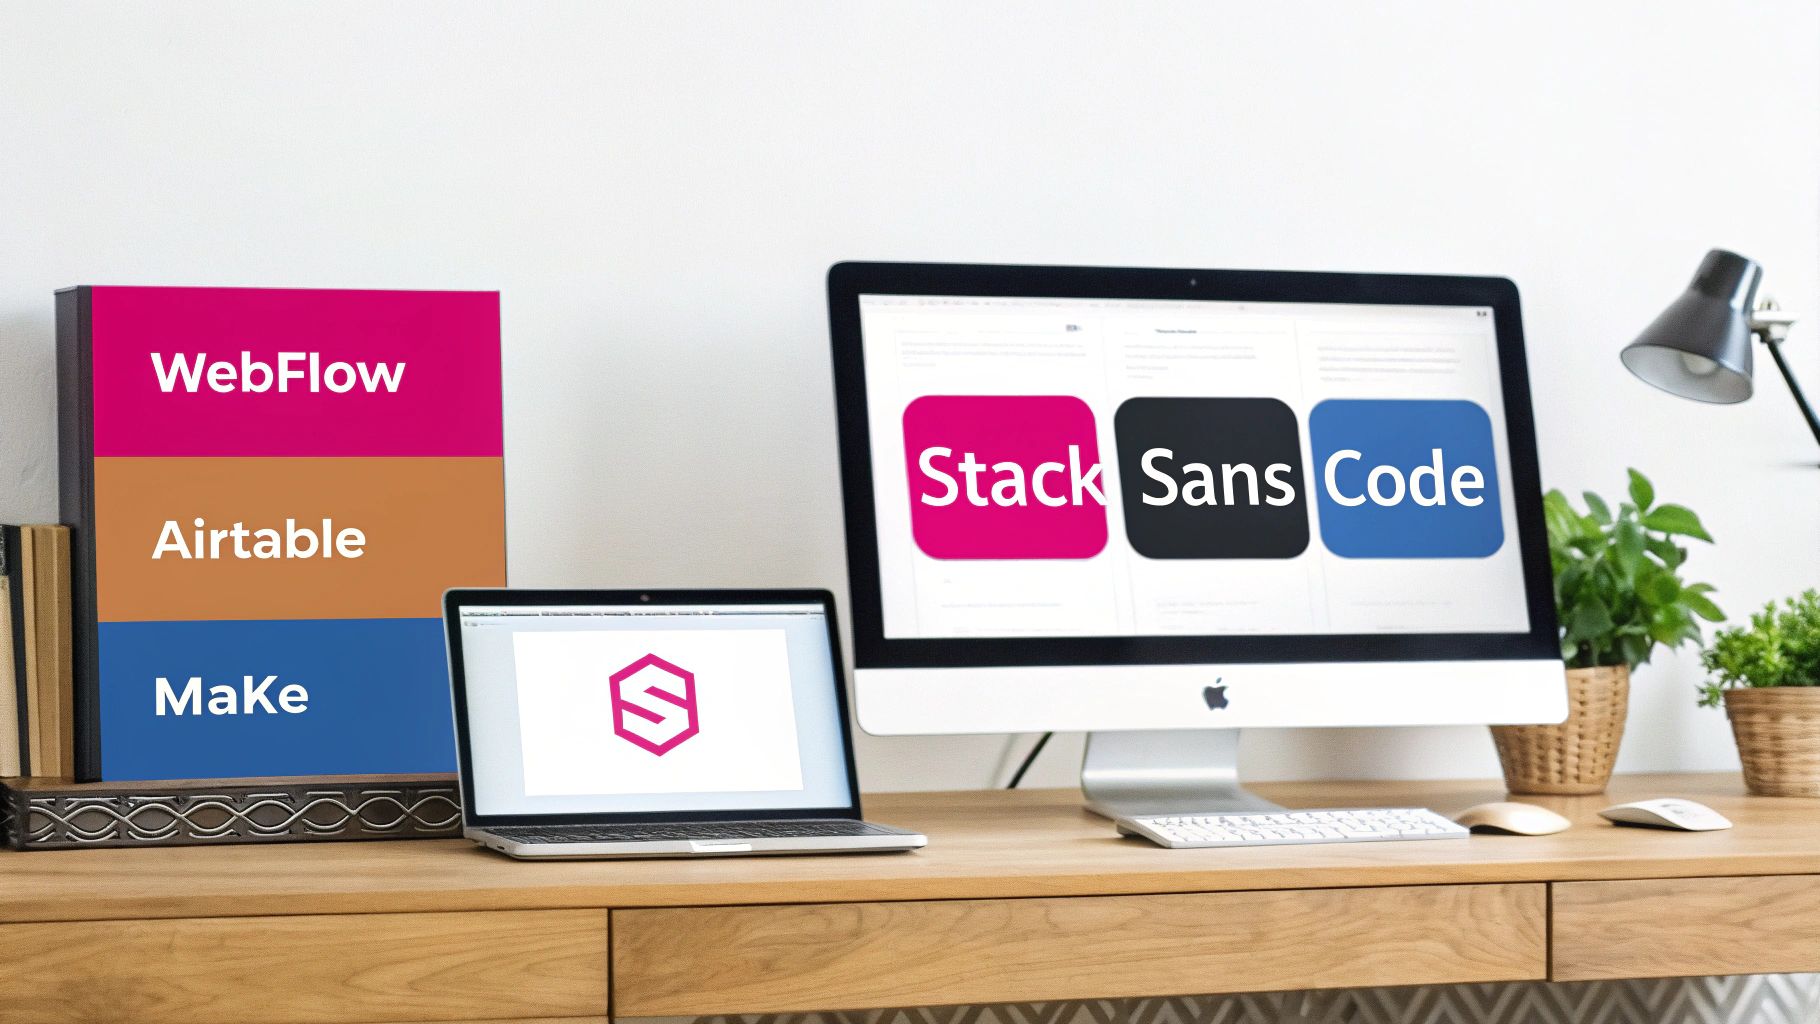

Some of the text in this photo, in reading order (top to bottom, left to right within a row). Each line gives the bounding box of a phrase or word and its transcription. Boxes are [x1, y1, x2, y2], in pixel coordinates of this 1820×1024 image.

[150, 351, 406, 393] WebFlow
[918, 444, 1485, 507] Stack Sans Code
[151, 517, 366, 559] Airtable
[155, 675, 309, 716] MaKe
